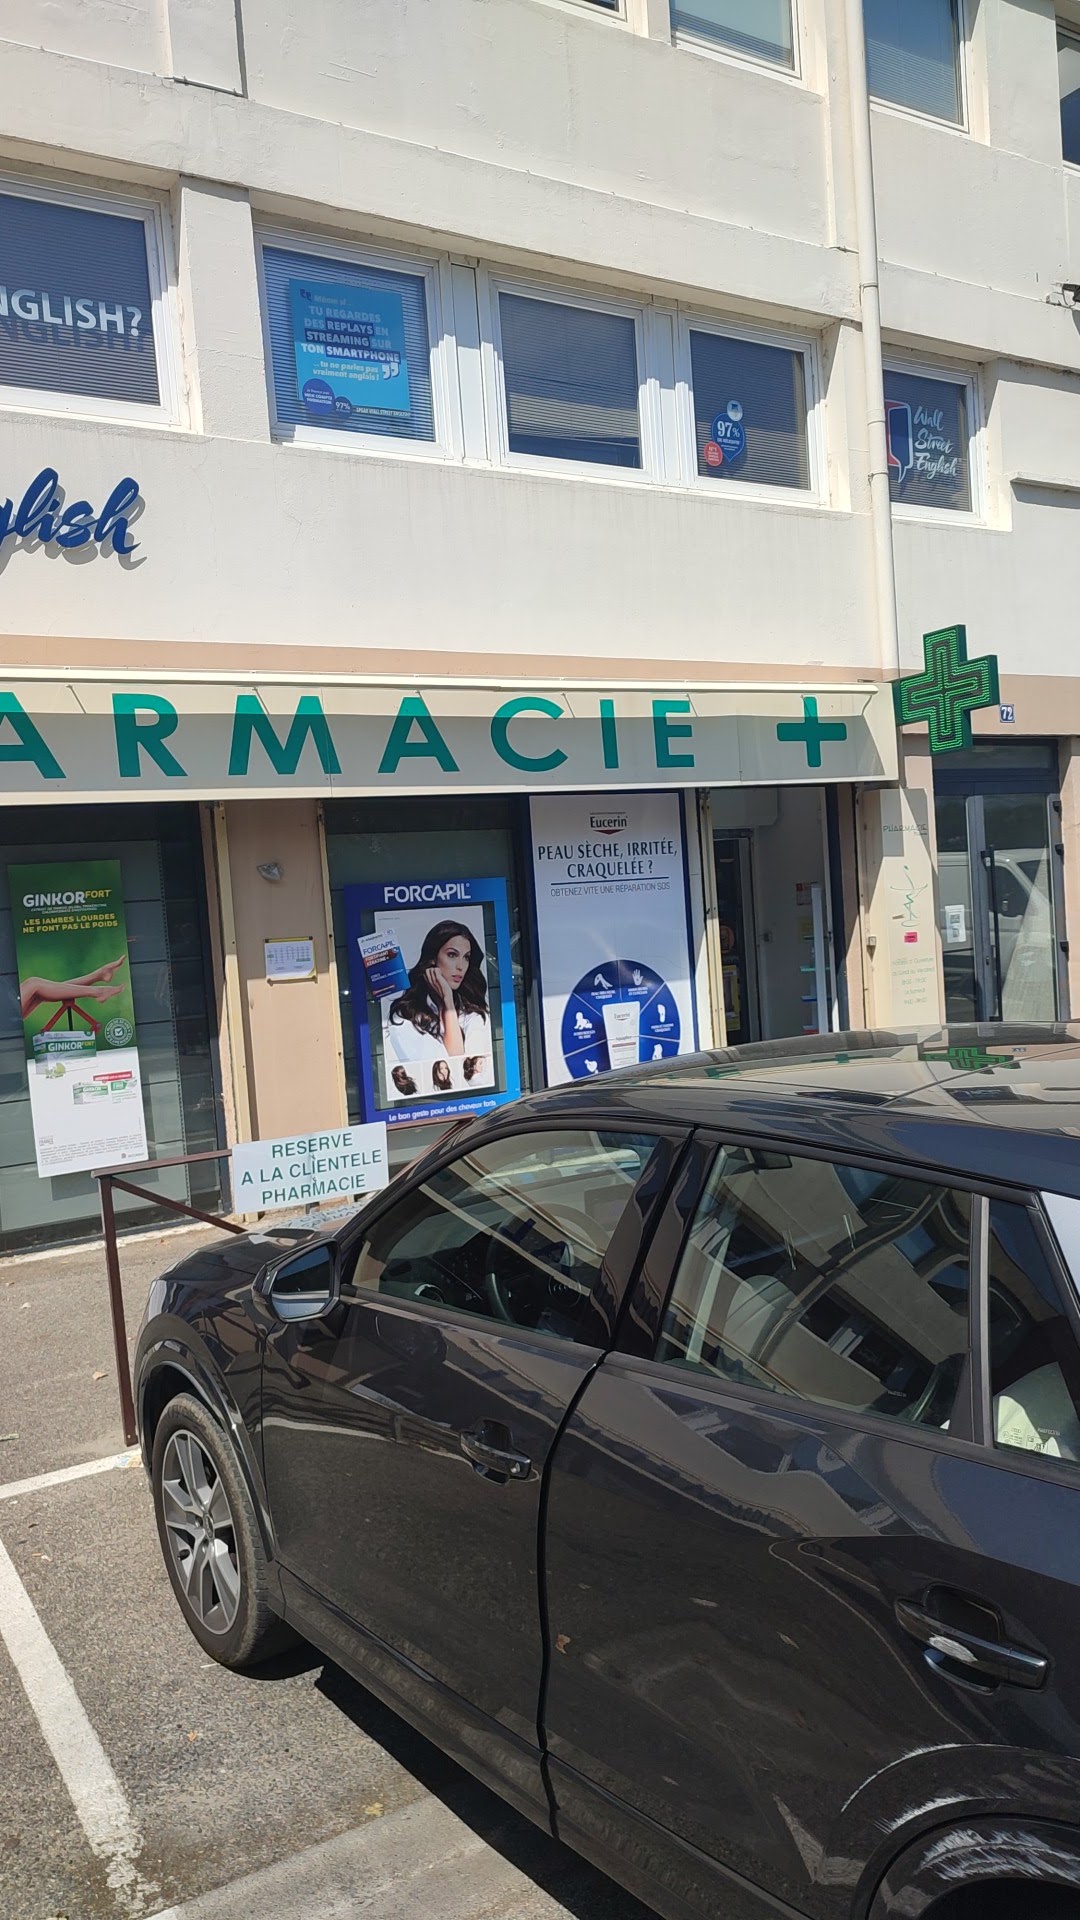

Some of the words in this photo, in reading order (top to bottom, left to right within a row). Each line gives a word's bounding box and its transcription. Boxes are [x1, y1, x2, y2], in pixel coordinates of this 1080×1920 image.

[308, 306, 323, 316] TU
[325, 307, 381, 323] REGARDES
[304, 318, 325, 328] DES
[327, 321, 373, 335] REPLAYS
[375, 327, 389, 336] EN
[306, 331, 369, 347] STREAMING
[370, 339, 392, 349] SUR
[301, 343, 325, 354] TON
[326, 346, 400, 362] SMARTPHONE
[313, 369, 347, 378] vraiment
[348, 372, 375, 381] anglais
[341, 362, 364, 372] parles
[335, 401, 350, 411] 97%
[914, 406, 943, 431] Wall
[717, 421, 740, 438] 97%
[914, 428, 954, 453] Street
[914, 452, 958, 479] English
[1001, 706, 1013, 720] 72
[590, 816, 627, 828] Eucerin
[538, 845, 573, 860] PEAU
[578, 840, 623, 860] SÈCHE,
[627, 837, 678, 857] IRRITÉE,
[567, 857, 644, 879] CRAQUELÉE
[23, 891, 85, 908] GINKOR
[85, 889, 112, 899] FORT
[383, 883, 471, 903] FORCAPIL
[551, 886, 582, 897] OBTENEZ
[583, 886, 599, 895] VITE
[600, 885, 614, 894] UNE
[615, 882, 656, 893] RÉPARATION
[657, 882, 670, 890] SOS
[37, 924, 60, 932] FONT
[93, 920, 118, 928] POIDS
[76, 913, 115, 922] LOURDES
[363, 941, 395, 955] FORCAPIL
[48, 1041, 82, 1052] GINKOR
[389, 1114, 396, 1122] Le
[412, 1109, 429, 1120] geste
[430, 1108, 445, 1116] pour
[458, 1102, 482, 1111] cheveux
[271, 1132, 353, 1159] RESERVE
[241, 1171, 253, 1185] A
[260, 1164, 284, 1182] LA
[289, 1149, 382, 1178] CLIENTELE
[262, 1173, 366, 1204] PHARMACIE
